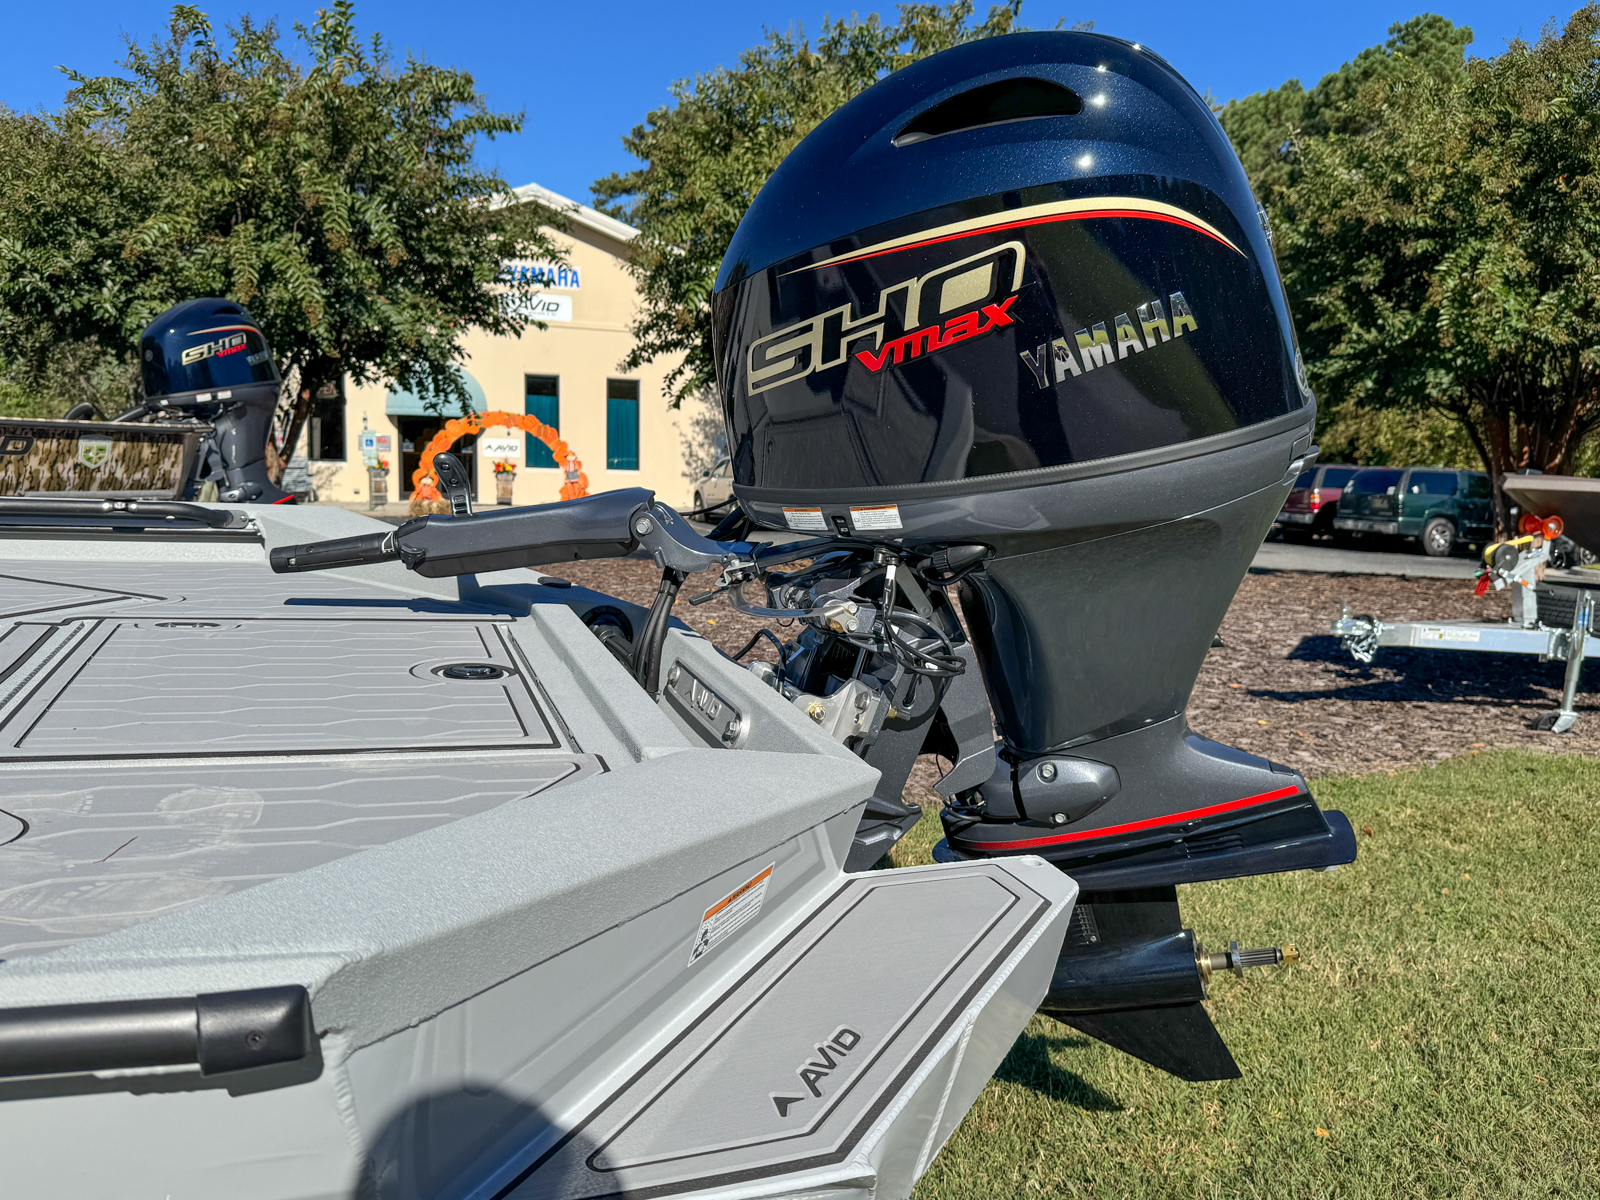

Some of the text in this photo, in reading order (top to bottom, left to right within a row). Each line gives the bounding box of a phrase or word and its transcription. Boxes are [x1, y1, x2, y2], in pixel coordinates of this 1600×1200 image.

[747, 240, 1026, 398] SHO
[1019, 290, 1198, 390] YAMAHA
[799, 1028, 861, 1099] AVID
